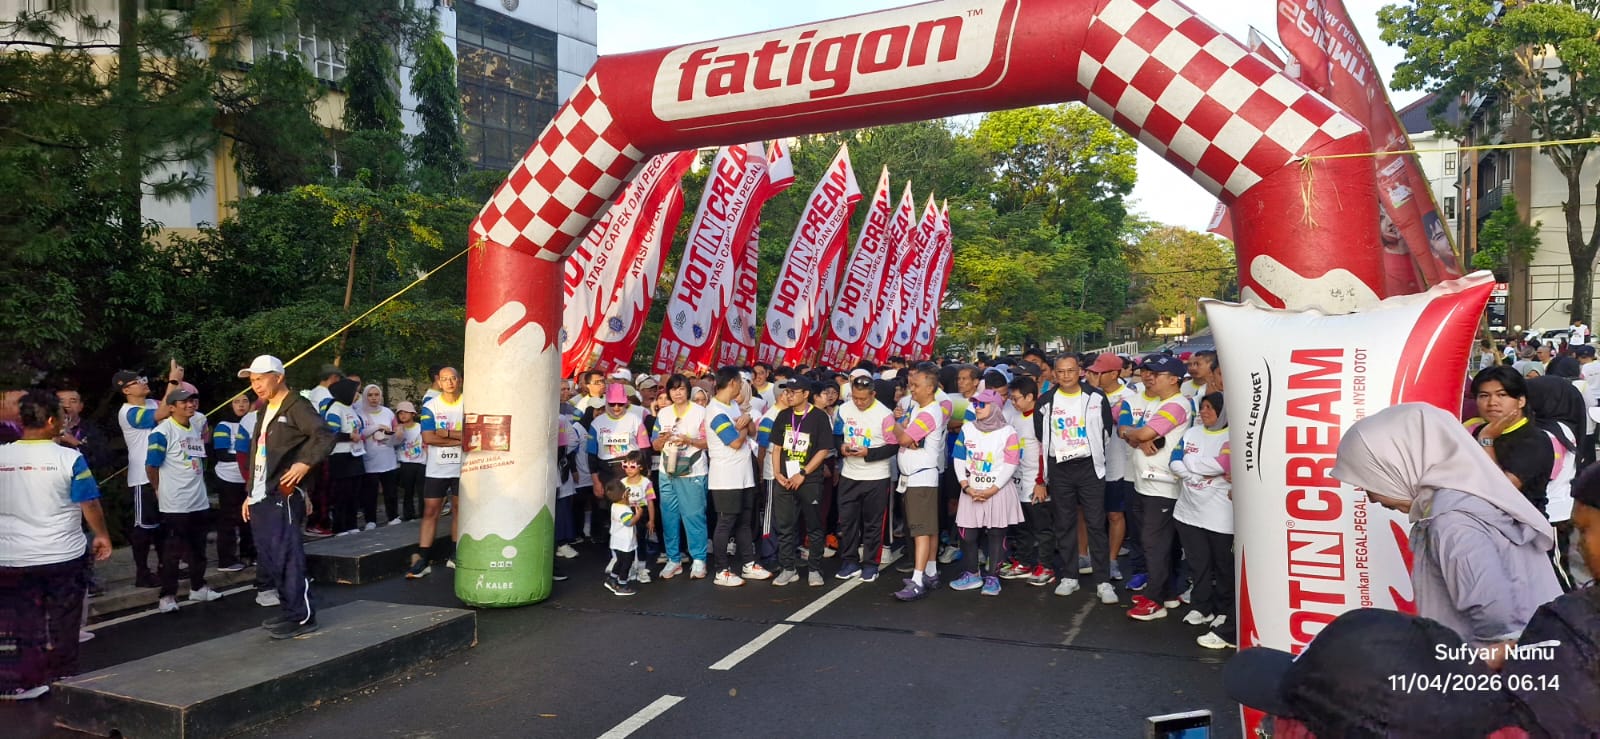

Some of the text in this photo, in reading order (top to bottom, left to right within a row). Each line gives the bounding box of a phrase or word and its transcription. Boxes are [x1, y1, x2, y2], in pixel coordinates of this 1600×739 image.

[677, 15, 964, 101] fatigon
[707, 143, 749, 222] CREA
[802, 158, 847, 246] CREAM
[585, 253, 609, 291] ATASI
[605, 210, 633, 251] CAPEK
[628, 183, 647, 209] DAN
[642, 153, 669, 187] PEGA
[709, 259, 726, 290] ATASI
[727, 198, 744, 223] DAN
[740, 164, 762, 198] PEGAL
[817, 227, 832, 246] DAN
[632, 245, 648, 279] ATASI
[1354, 348, 1368, 373] OTOT
[1353, 375, 1366, 405] NYERI
[1061, 426, 1087, 440] RUN
[1245, 371, 1262, 471] TIDAK LENGKET
[1285, 348, 1345, 521] CREAM
[789, 437, 806, 446] 007
[485, 582, 514, 590] KALBE
[1356, 571, 1374, 610] gankan
